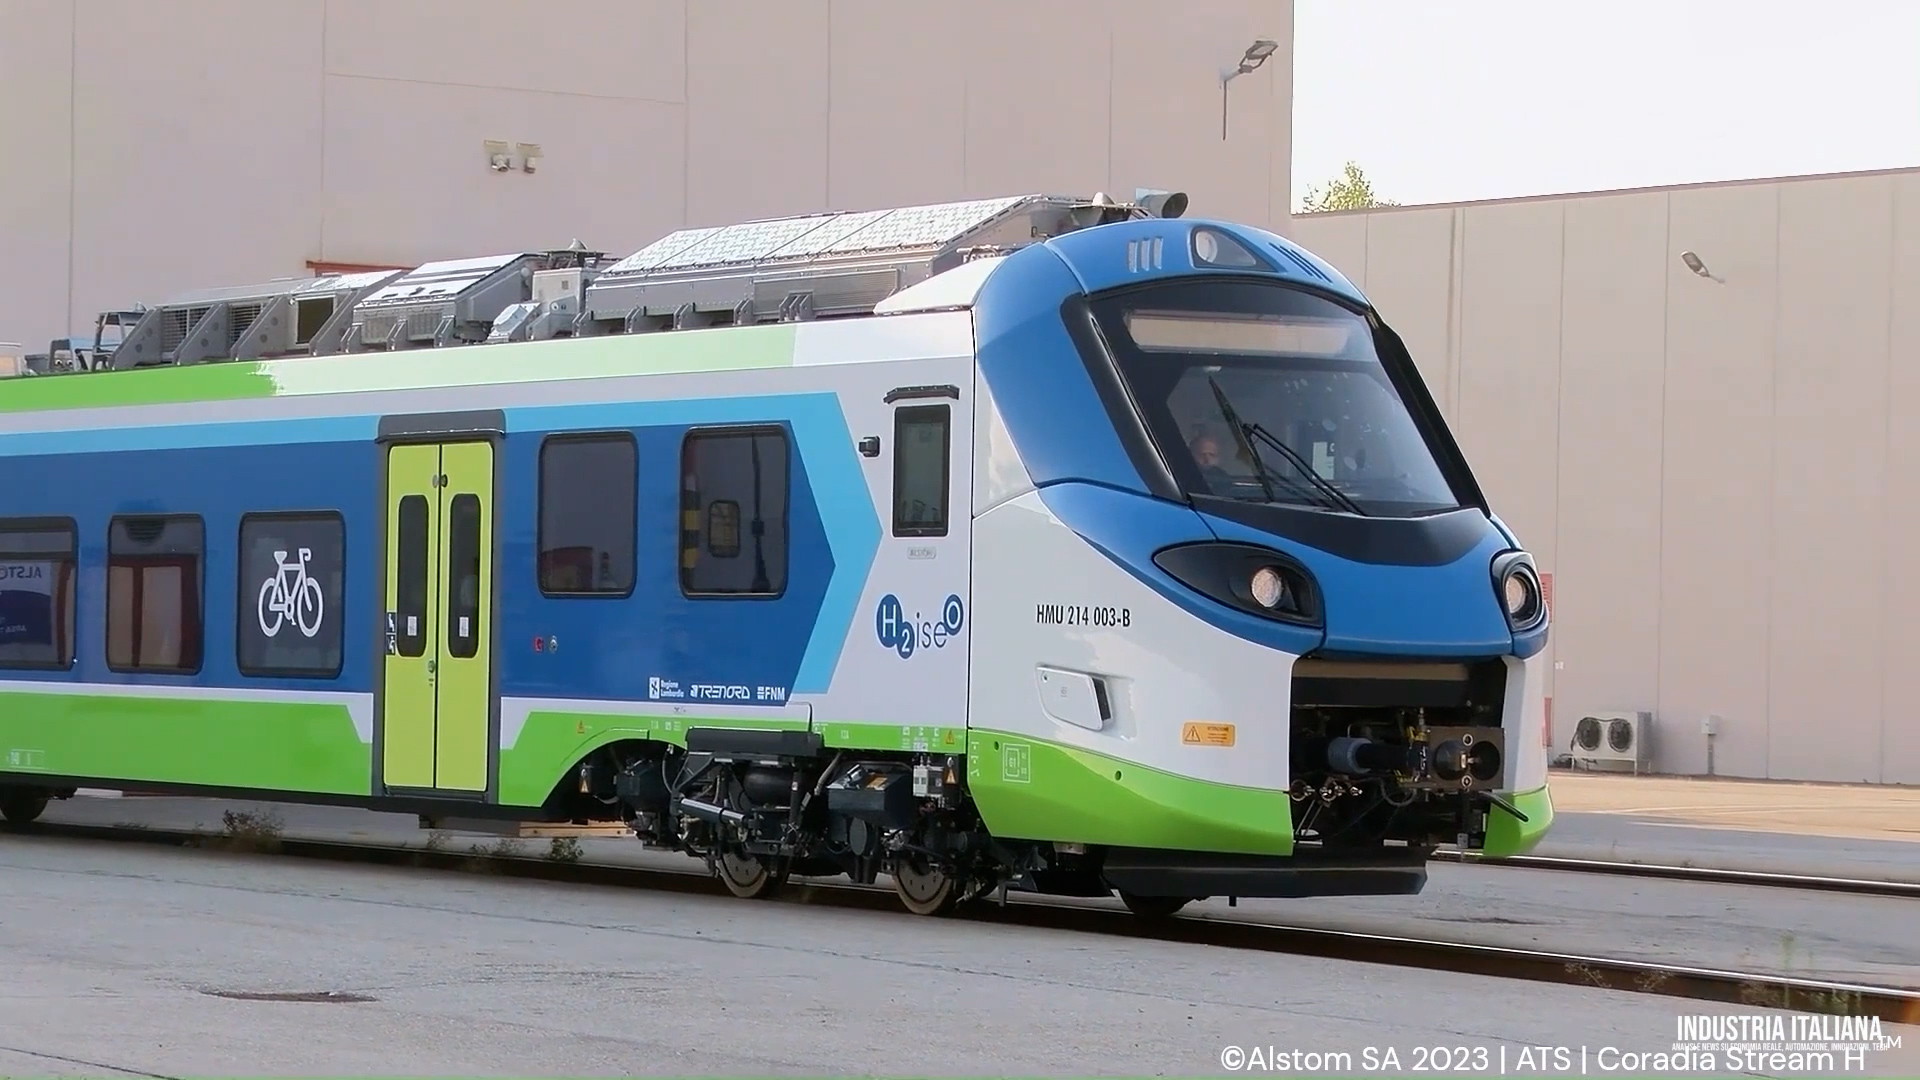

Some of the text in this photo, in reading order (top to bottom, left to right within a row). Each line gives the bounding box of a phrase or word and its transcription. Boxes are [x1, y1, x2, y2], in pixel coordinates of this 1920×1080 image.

[1036, 604, 1131, 627] HMU 214 003-B
[699, 685, 751, 699] TRENORD
[765, 687, 785, 700] FNM
